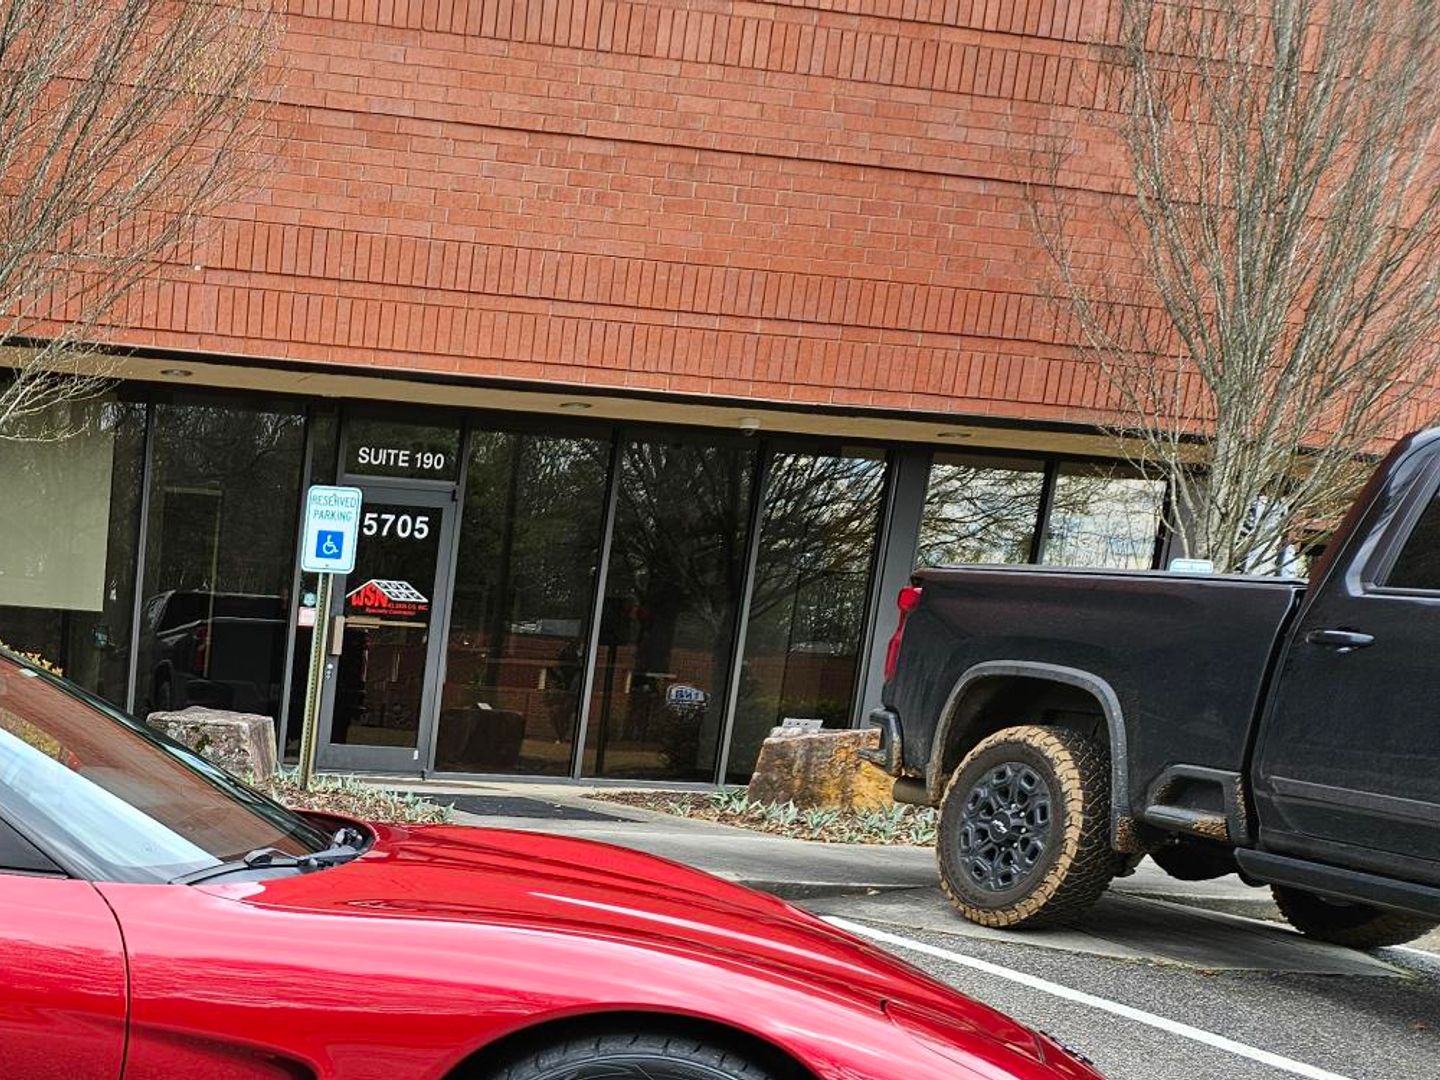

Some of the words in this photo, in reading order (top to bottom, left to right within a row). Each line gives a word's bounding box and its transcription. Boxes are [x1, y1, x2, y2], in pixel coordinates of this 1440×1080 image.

[358, 447, 410, 467] SUITE
[415, 452, 445, 470] 190
[312, 494, 357, 508] RESERVED
[313, 509, 353, 521] PARKING
[363, 513, 429, 539] 5705
